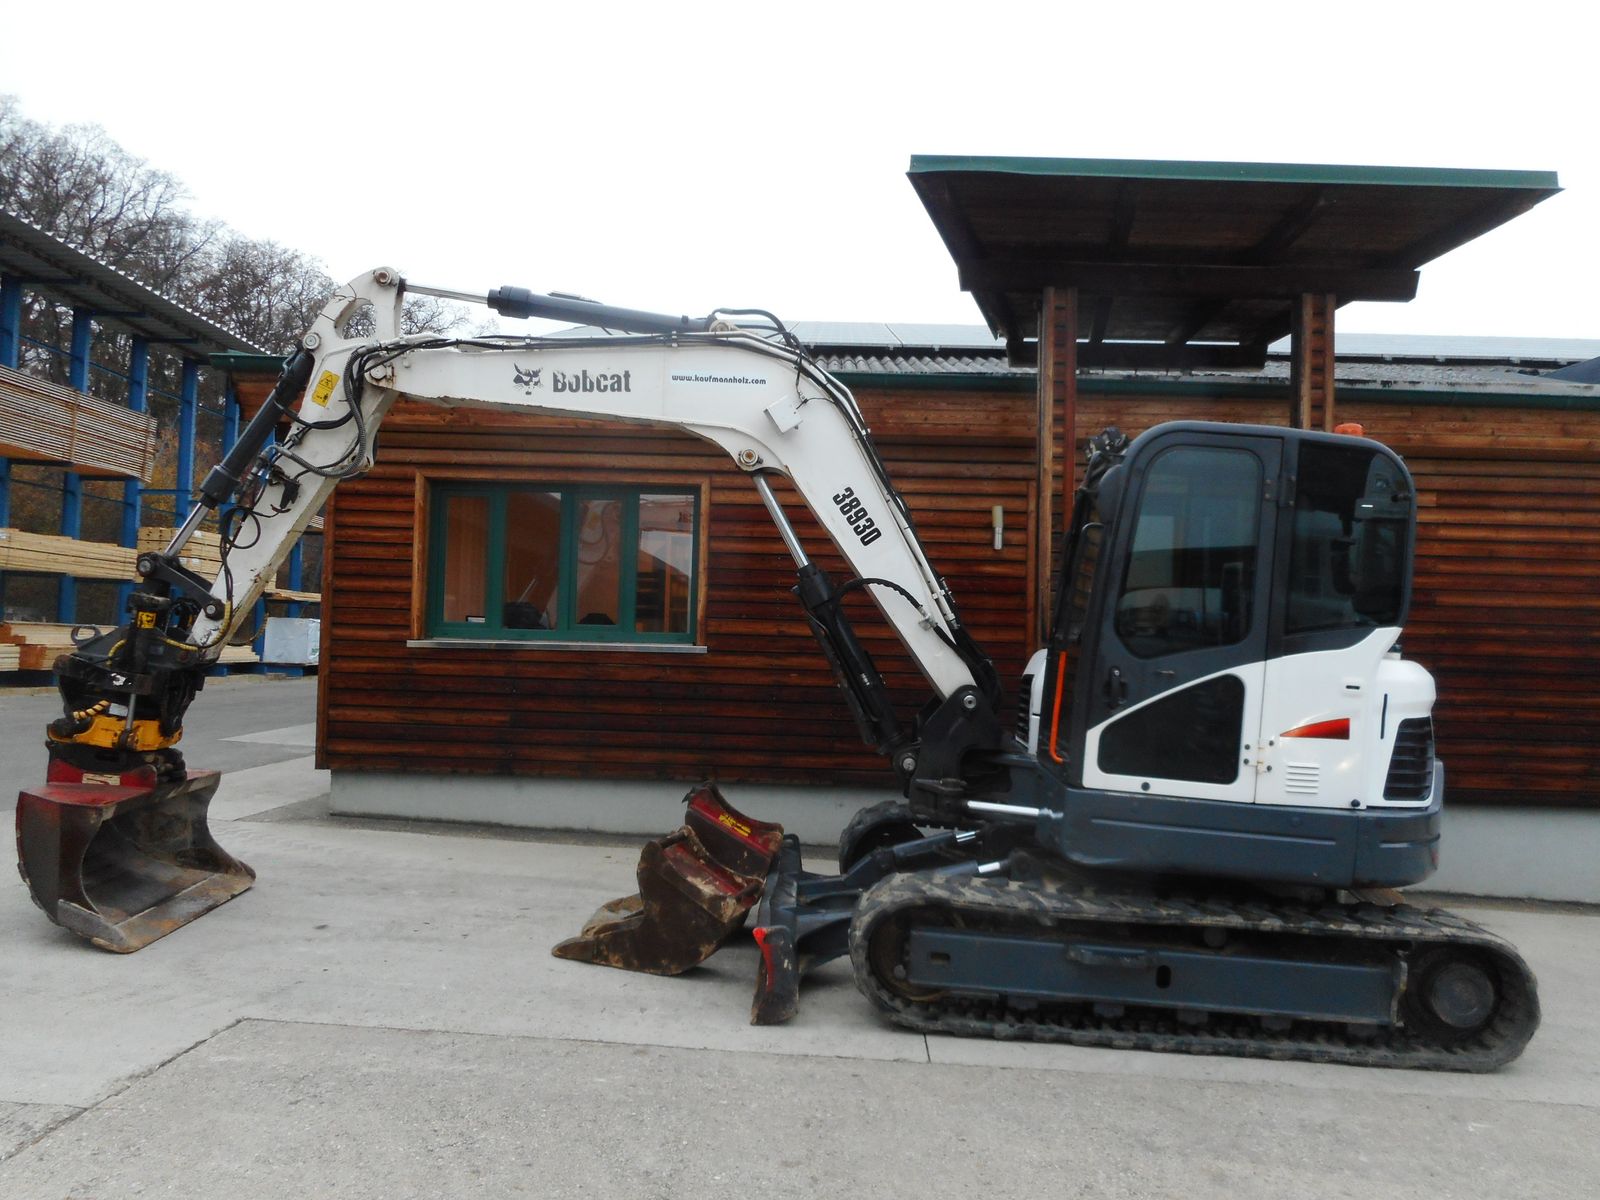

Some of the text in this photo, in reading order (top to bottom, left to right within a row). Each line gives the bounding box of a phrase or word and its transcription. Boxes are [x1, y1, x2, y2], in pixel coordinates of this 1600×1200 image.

[553, 369, 631, 393] Bobcat
[671, 374, 767, 385] www.kaufmannholz.com
[832, 486, 882, 547] 38930
